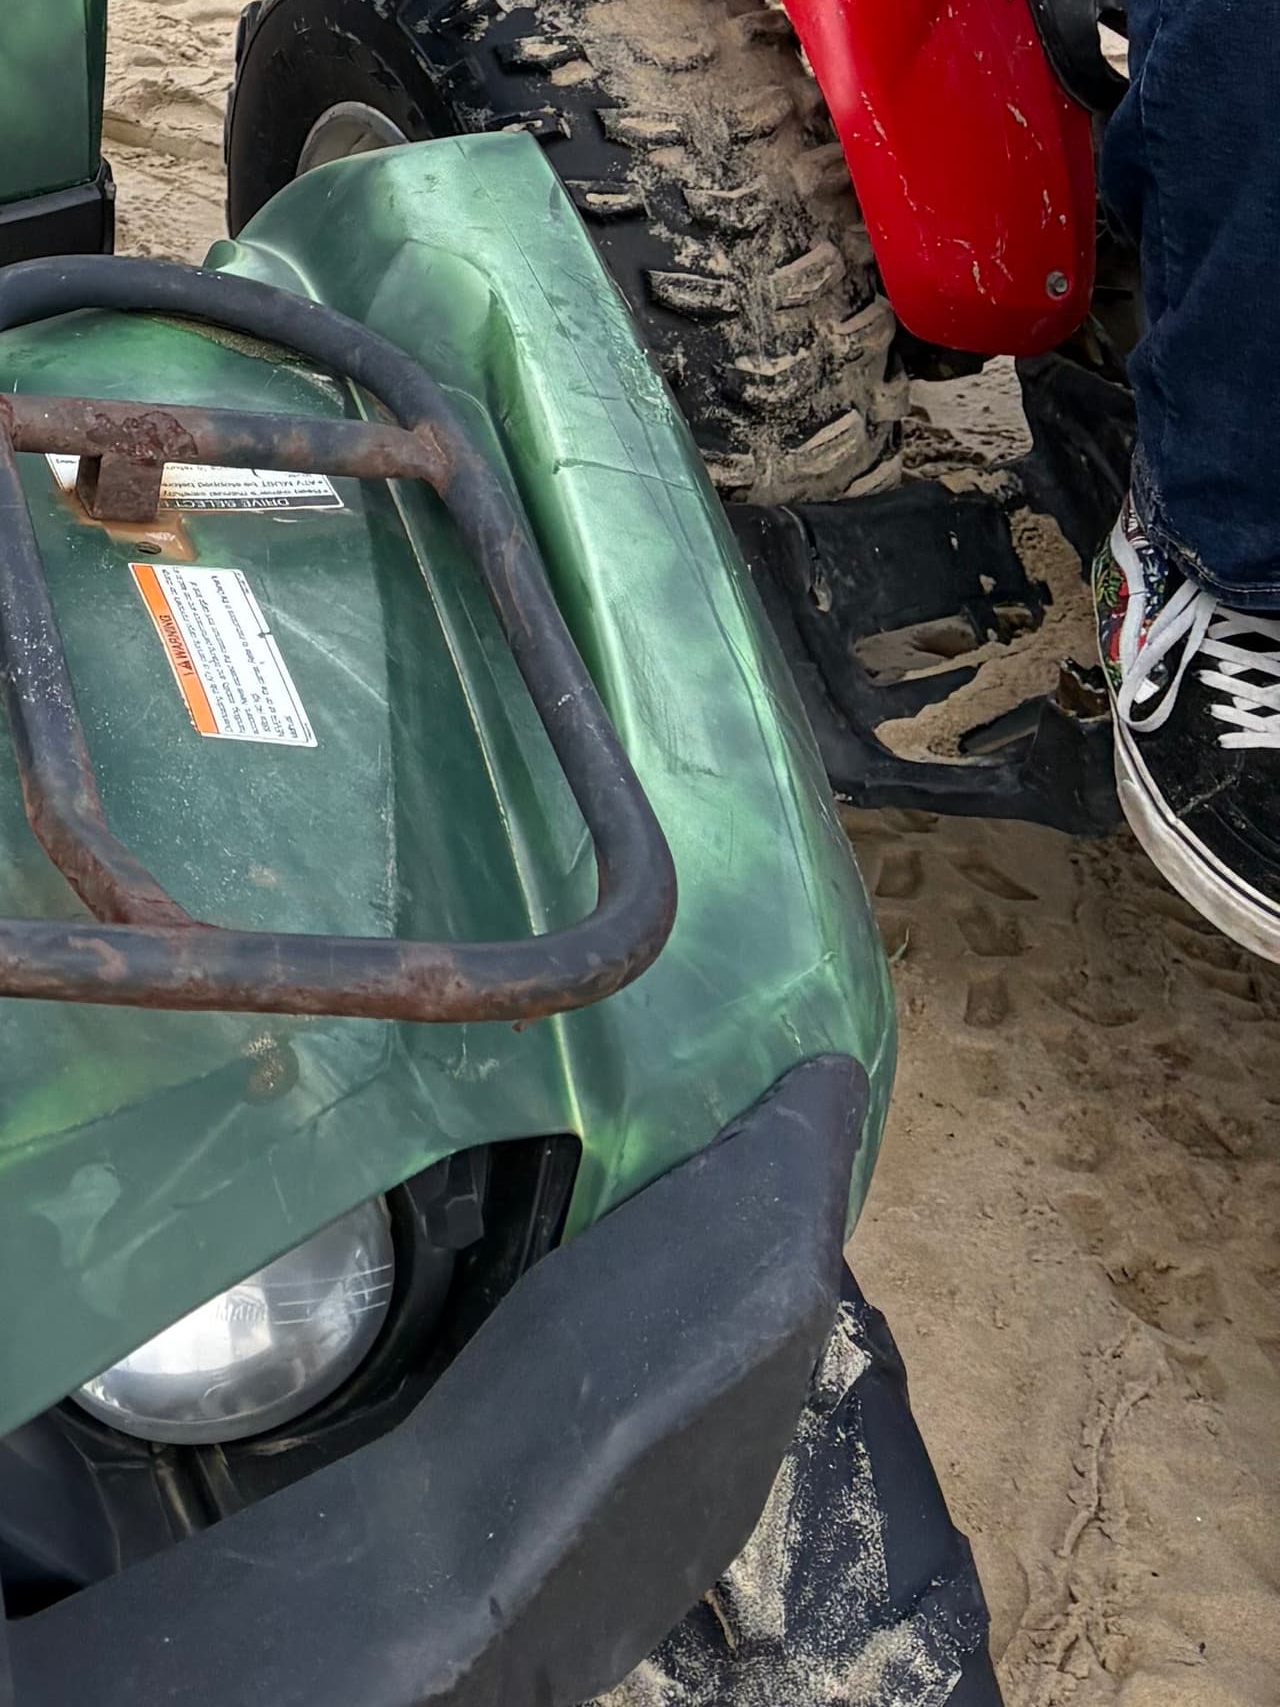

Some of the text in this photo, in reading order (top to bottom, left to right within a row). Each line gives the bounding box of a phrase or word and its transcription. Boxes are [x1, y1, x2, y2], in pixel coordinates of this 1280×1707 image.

[174, 498, 237, 508] SELECT
[240, 498, 290, 508] DRIVE
[160, 614, 188, 661] WARNING
